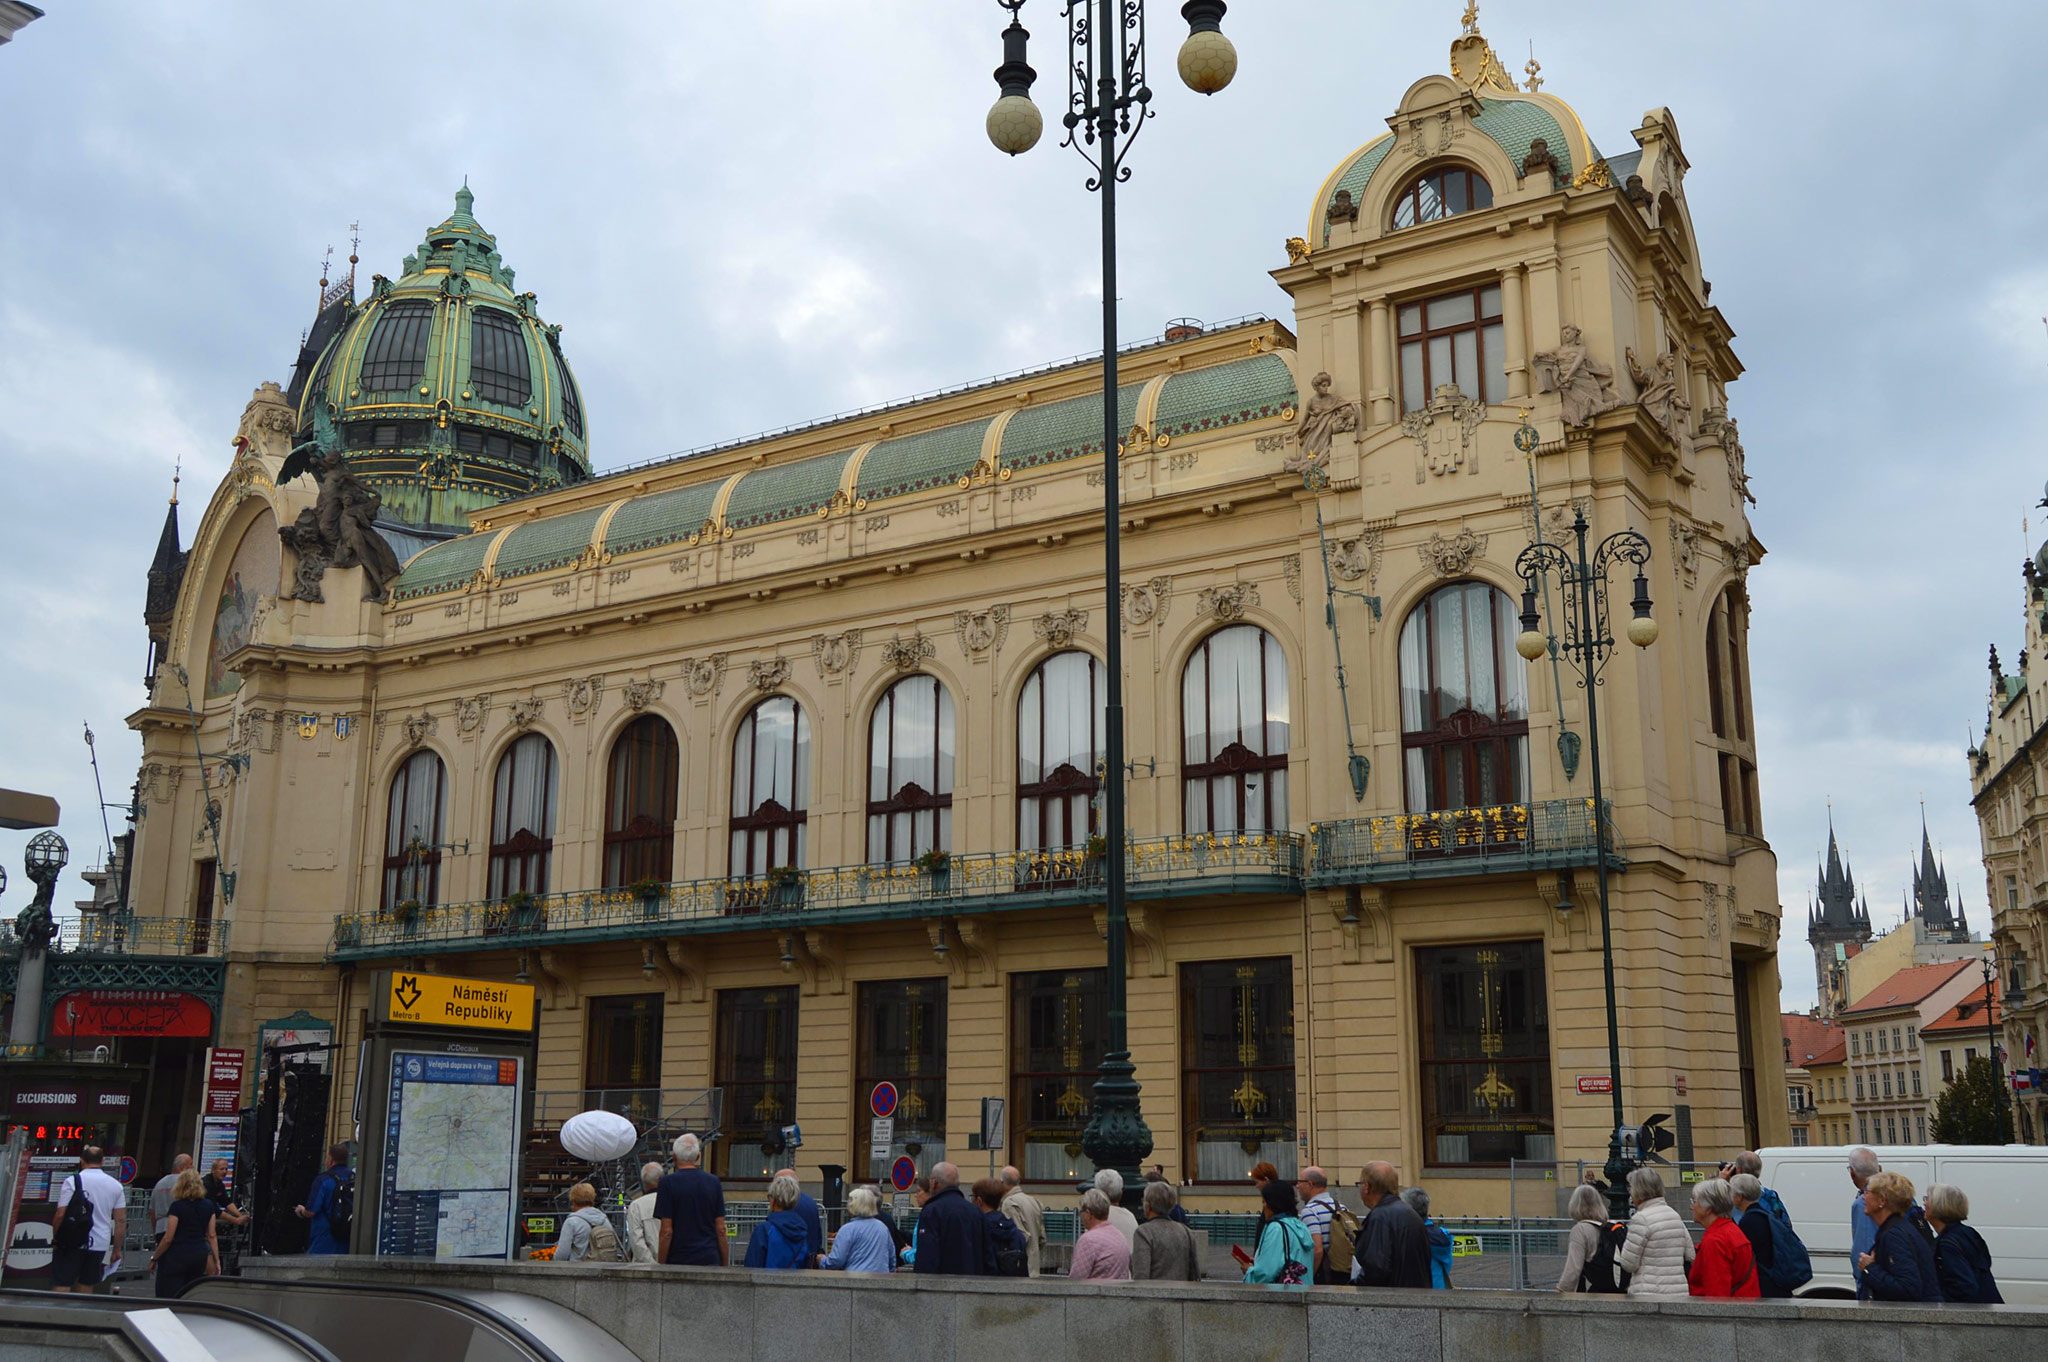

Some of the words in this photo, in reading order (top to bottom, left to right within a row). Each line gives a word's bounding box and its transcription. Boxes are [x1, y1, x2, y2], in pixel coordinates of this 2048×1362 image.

[453, 985, 509, 1003] Náměstí
[393, 1011, 413, 1019] Metro
[445, 1002, 513, 1024] Republiky
[447, 1044, 479, 1053] JCDecaux
[428, 1060, 450, 1070] Veřejná
[450, 1061, 472, 1071] doprava
[478, 1062, 492, 1070] Praze
[17, 1093, 78, 1104] EXCURSIONS
